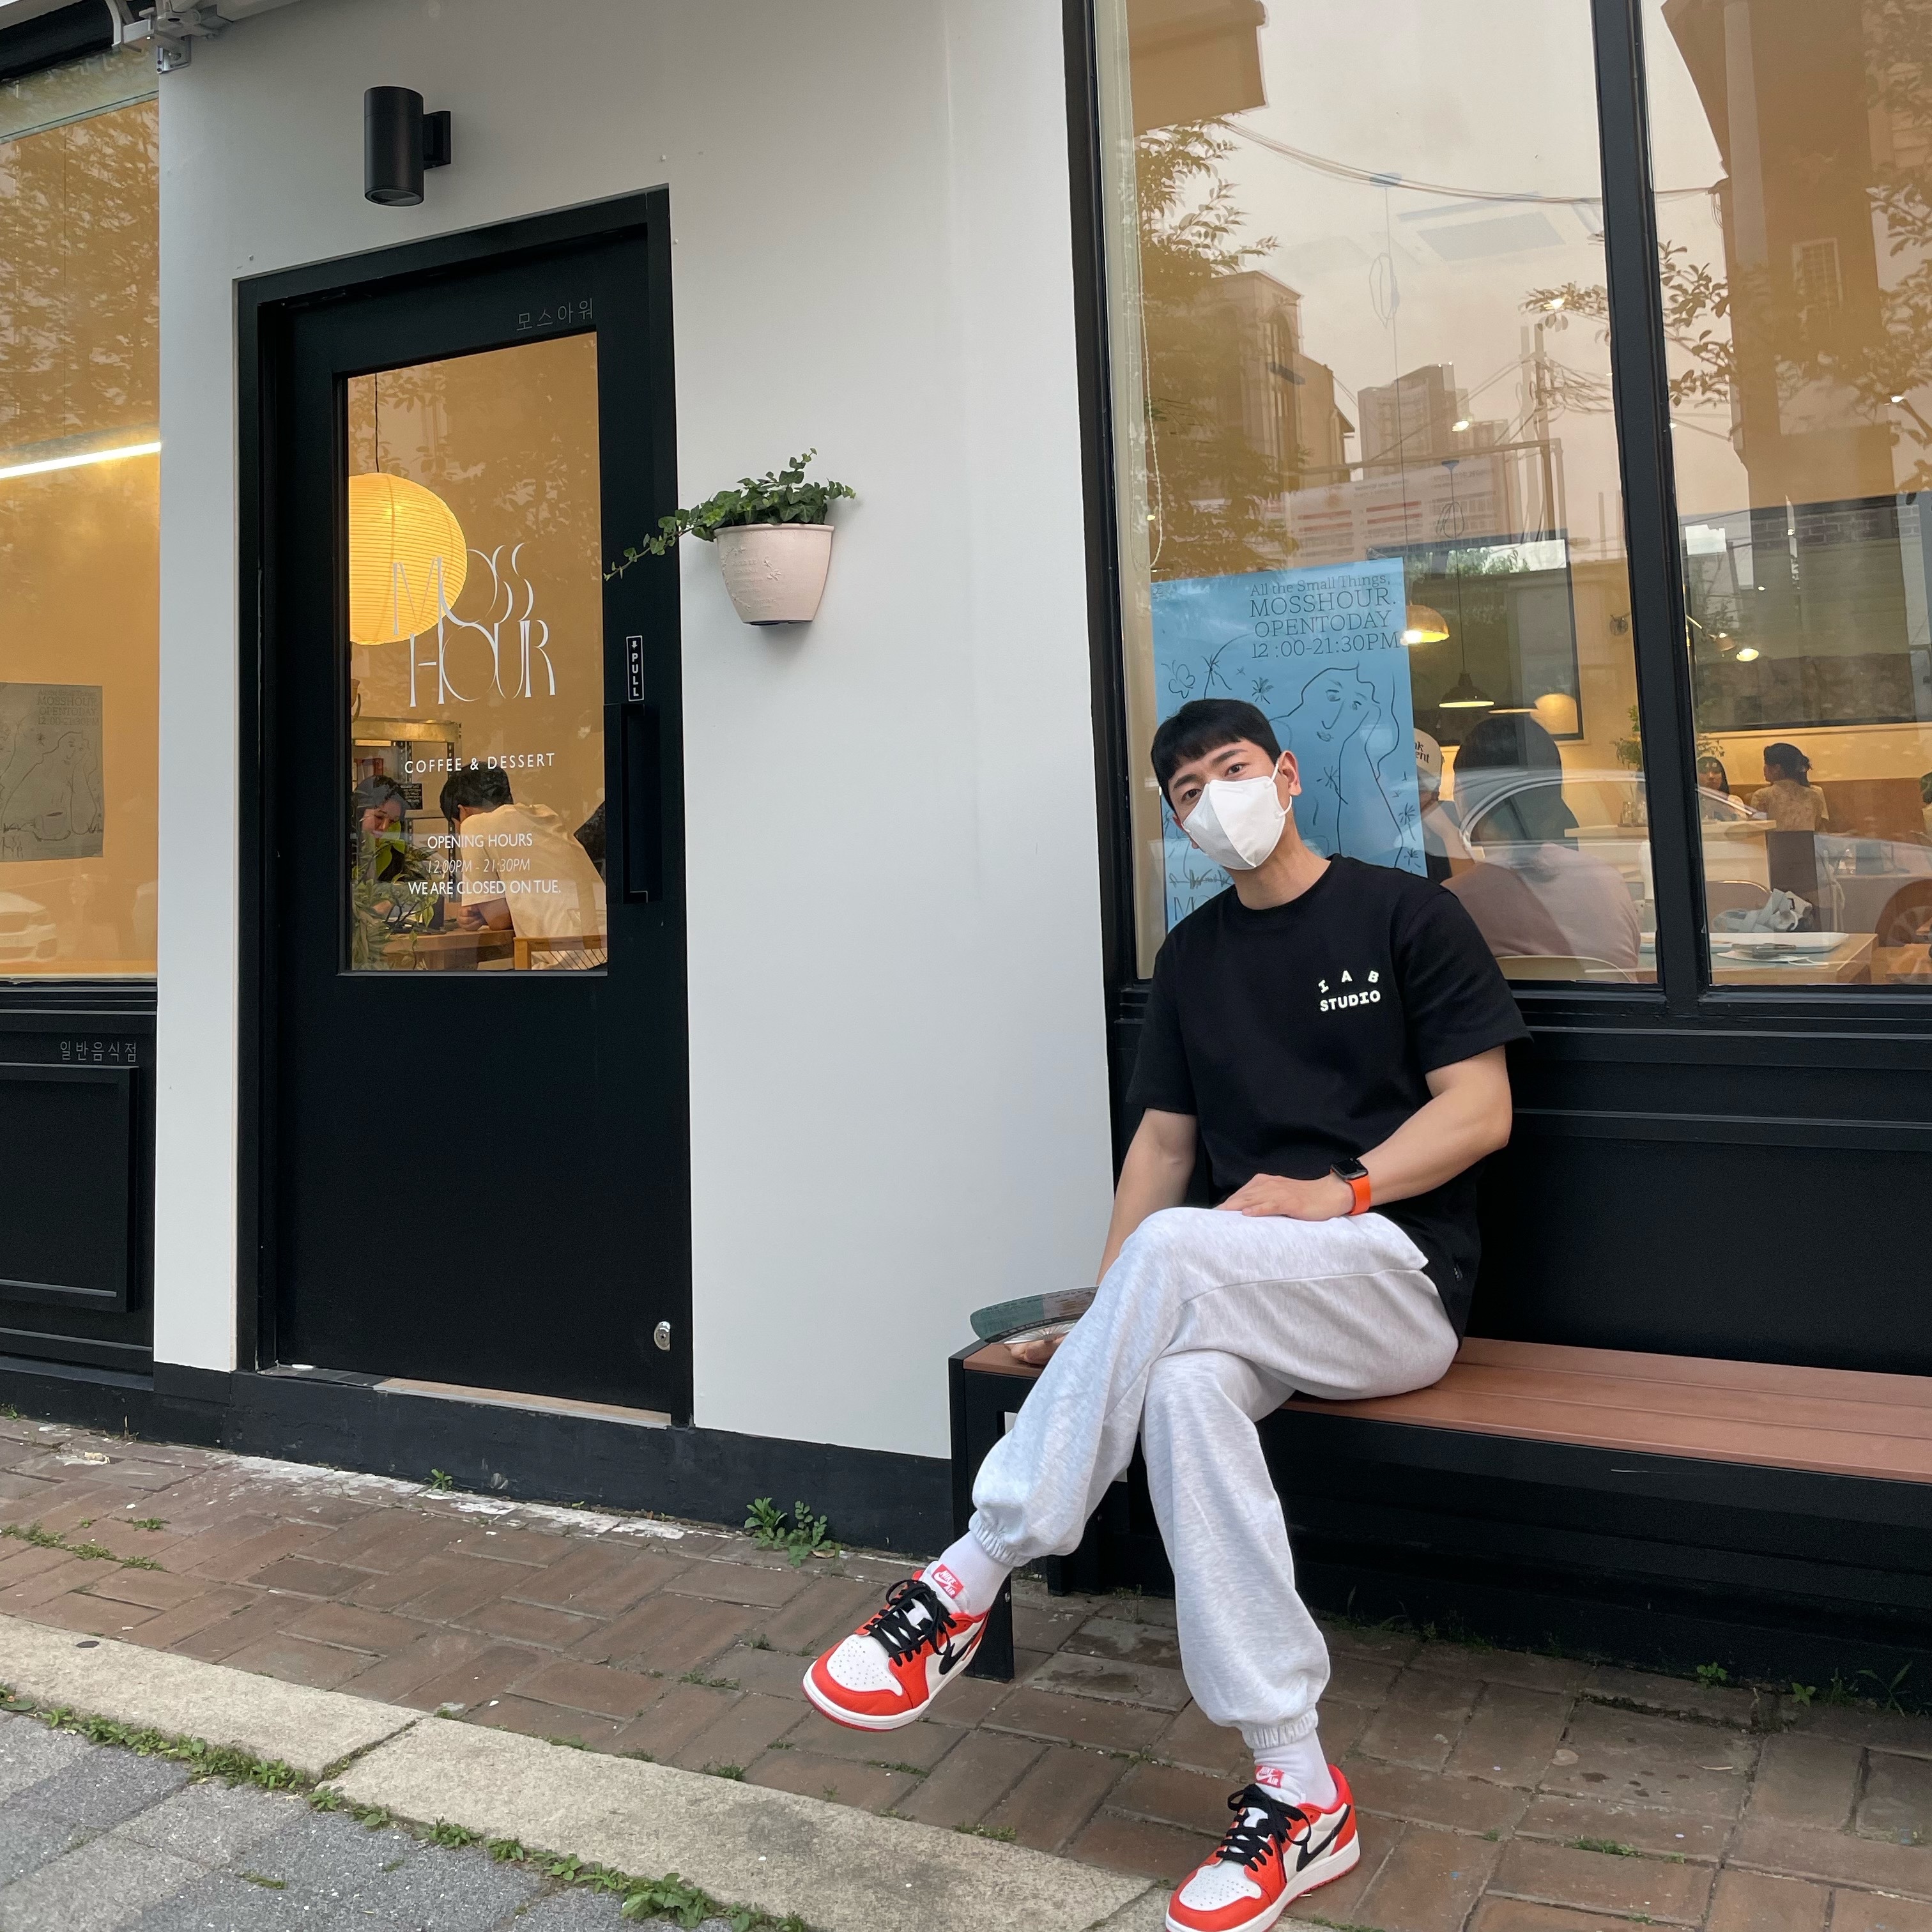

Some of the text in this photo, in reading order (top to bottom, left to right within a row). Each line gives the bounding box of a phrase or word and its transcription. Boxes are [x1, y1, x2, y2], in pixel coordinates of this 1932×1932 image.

[516, 297, 594, 332] 모스아워
[1250, 583, 1268, 597] All
[1272, 581, 1294, 595] the
[1298, 576, 1336, 592] Small
[1254, 610, 1392, 638] OPENTODAY
[410, 619, 556, 708] HOUR
[631, 652, 640, 697] PULL
[404, 753, 555, 774] COFFEE & DESSERT
[427, 832, 533, 849] OPENING HOURS
[428, 859, 472, 873] 12:00PM
[483, 858, 531, 873] 21:30PM
[408, 882, 428, 895] WE
[429, 882, 454, 895] ARE
[456, 880, 506, 894] CLOSED
[510, 880, 531, 894] ON
[1319, 990, 1381, 1012] STUDIO
[59, 1040, 137, 1062] 일반음식점
[939, 1570, 957, 1584] NIKE
[943, 1585, 956, 1597] AIR
[1266, 1776, 1278, 1786] AIR
